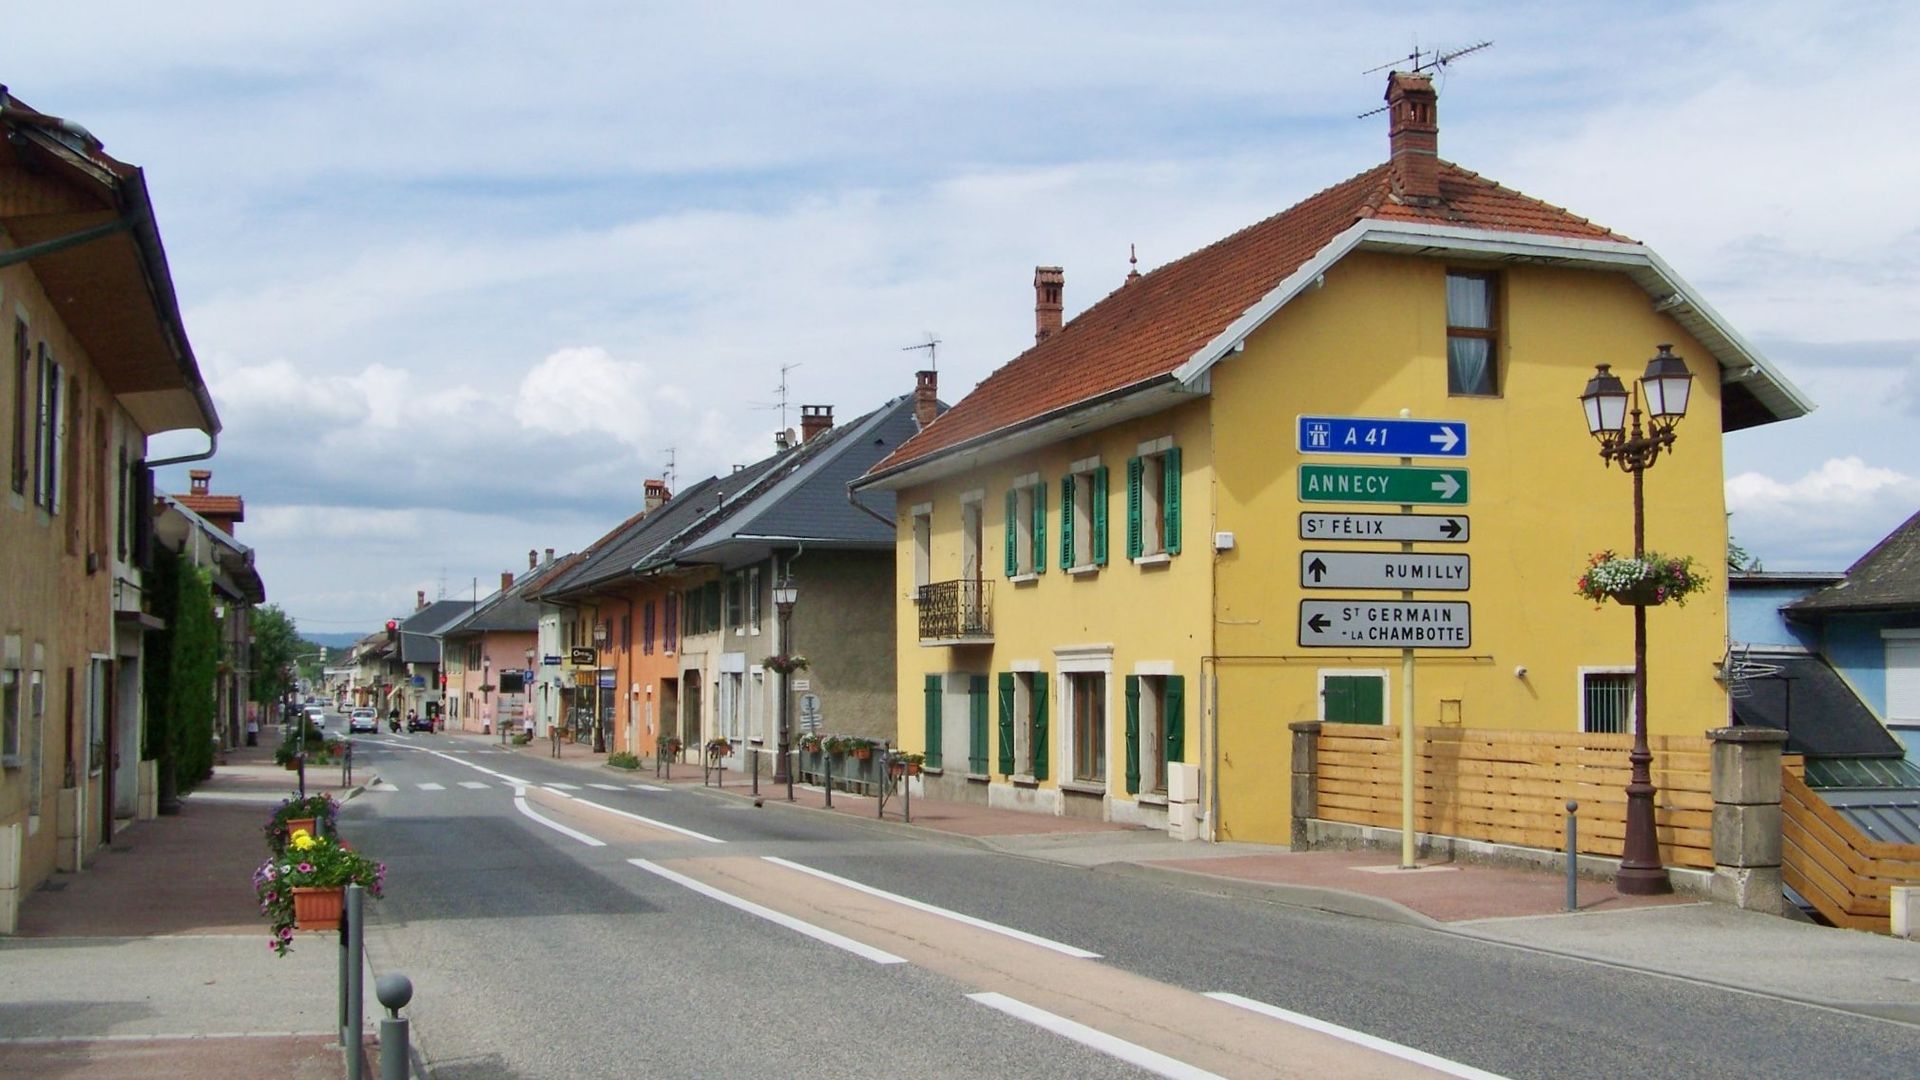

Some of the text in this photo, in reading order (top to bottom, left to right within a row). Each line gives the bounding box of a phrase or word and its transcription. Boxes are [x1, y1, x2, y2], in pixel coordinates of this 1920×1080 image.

[1344, 427, 1388, 446] A 41
[1308, 475, 1390, 494] ANNECY
[1332, 517, 1383, 534] FÉLIX
[1385, 564, 1464, 579] RUMILLY
[1368, 608, 1452, 622] GERMAIN
[1369, 627, 1464, 641] CHAMBOTTE
